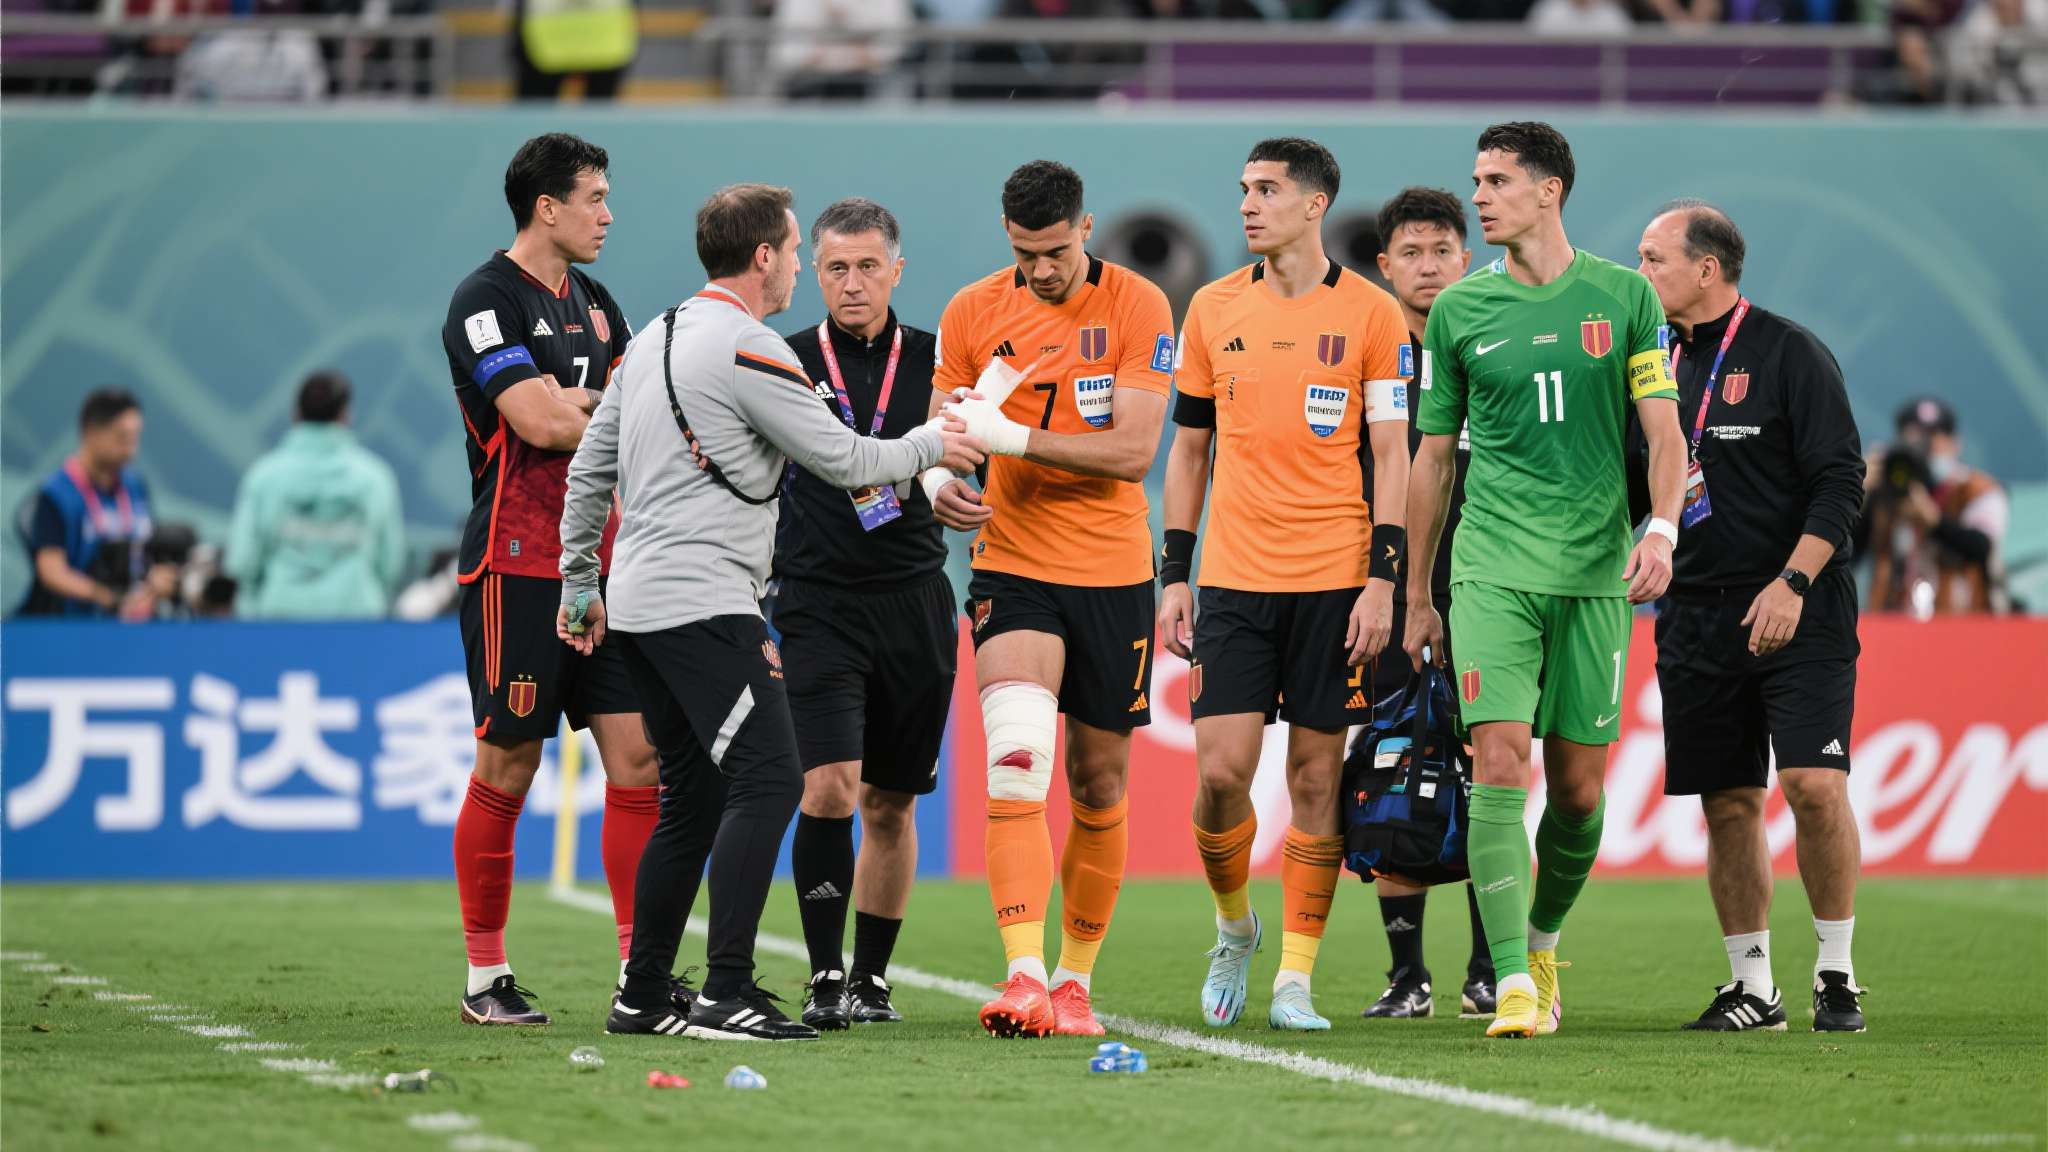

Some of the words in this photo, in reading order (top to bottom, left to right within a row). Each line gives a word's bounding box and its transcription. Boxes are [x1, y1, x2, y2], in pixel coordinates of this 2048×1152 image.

[573, 356, 590, 388] 7
[1533, 370, 1565, 423] 11
[1034, 382, 1058, 431] 7
[1133, 637, 1149, 690] 7
[1611, 649, 1622, 705] 1
